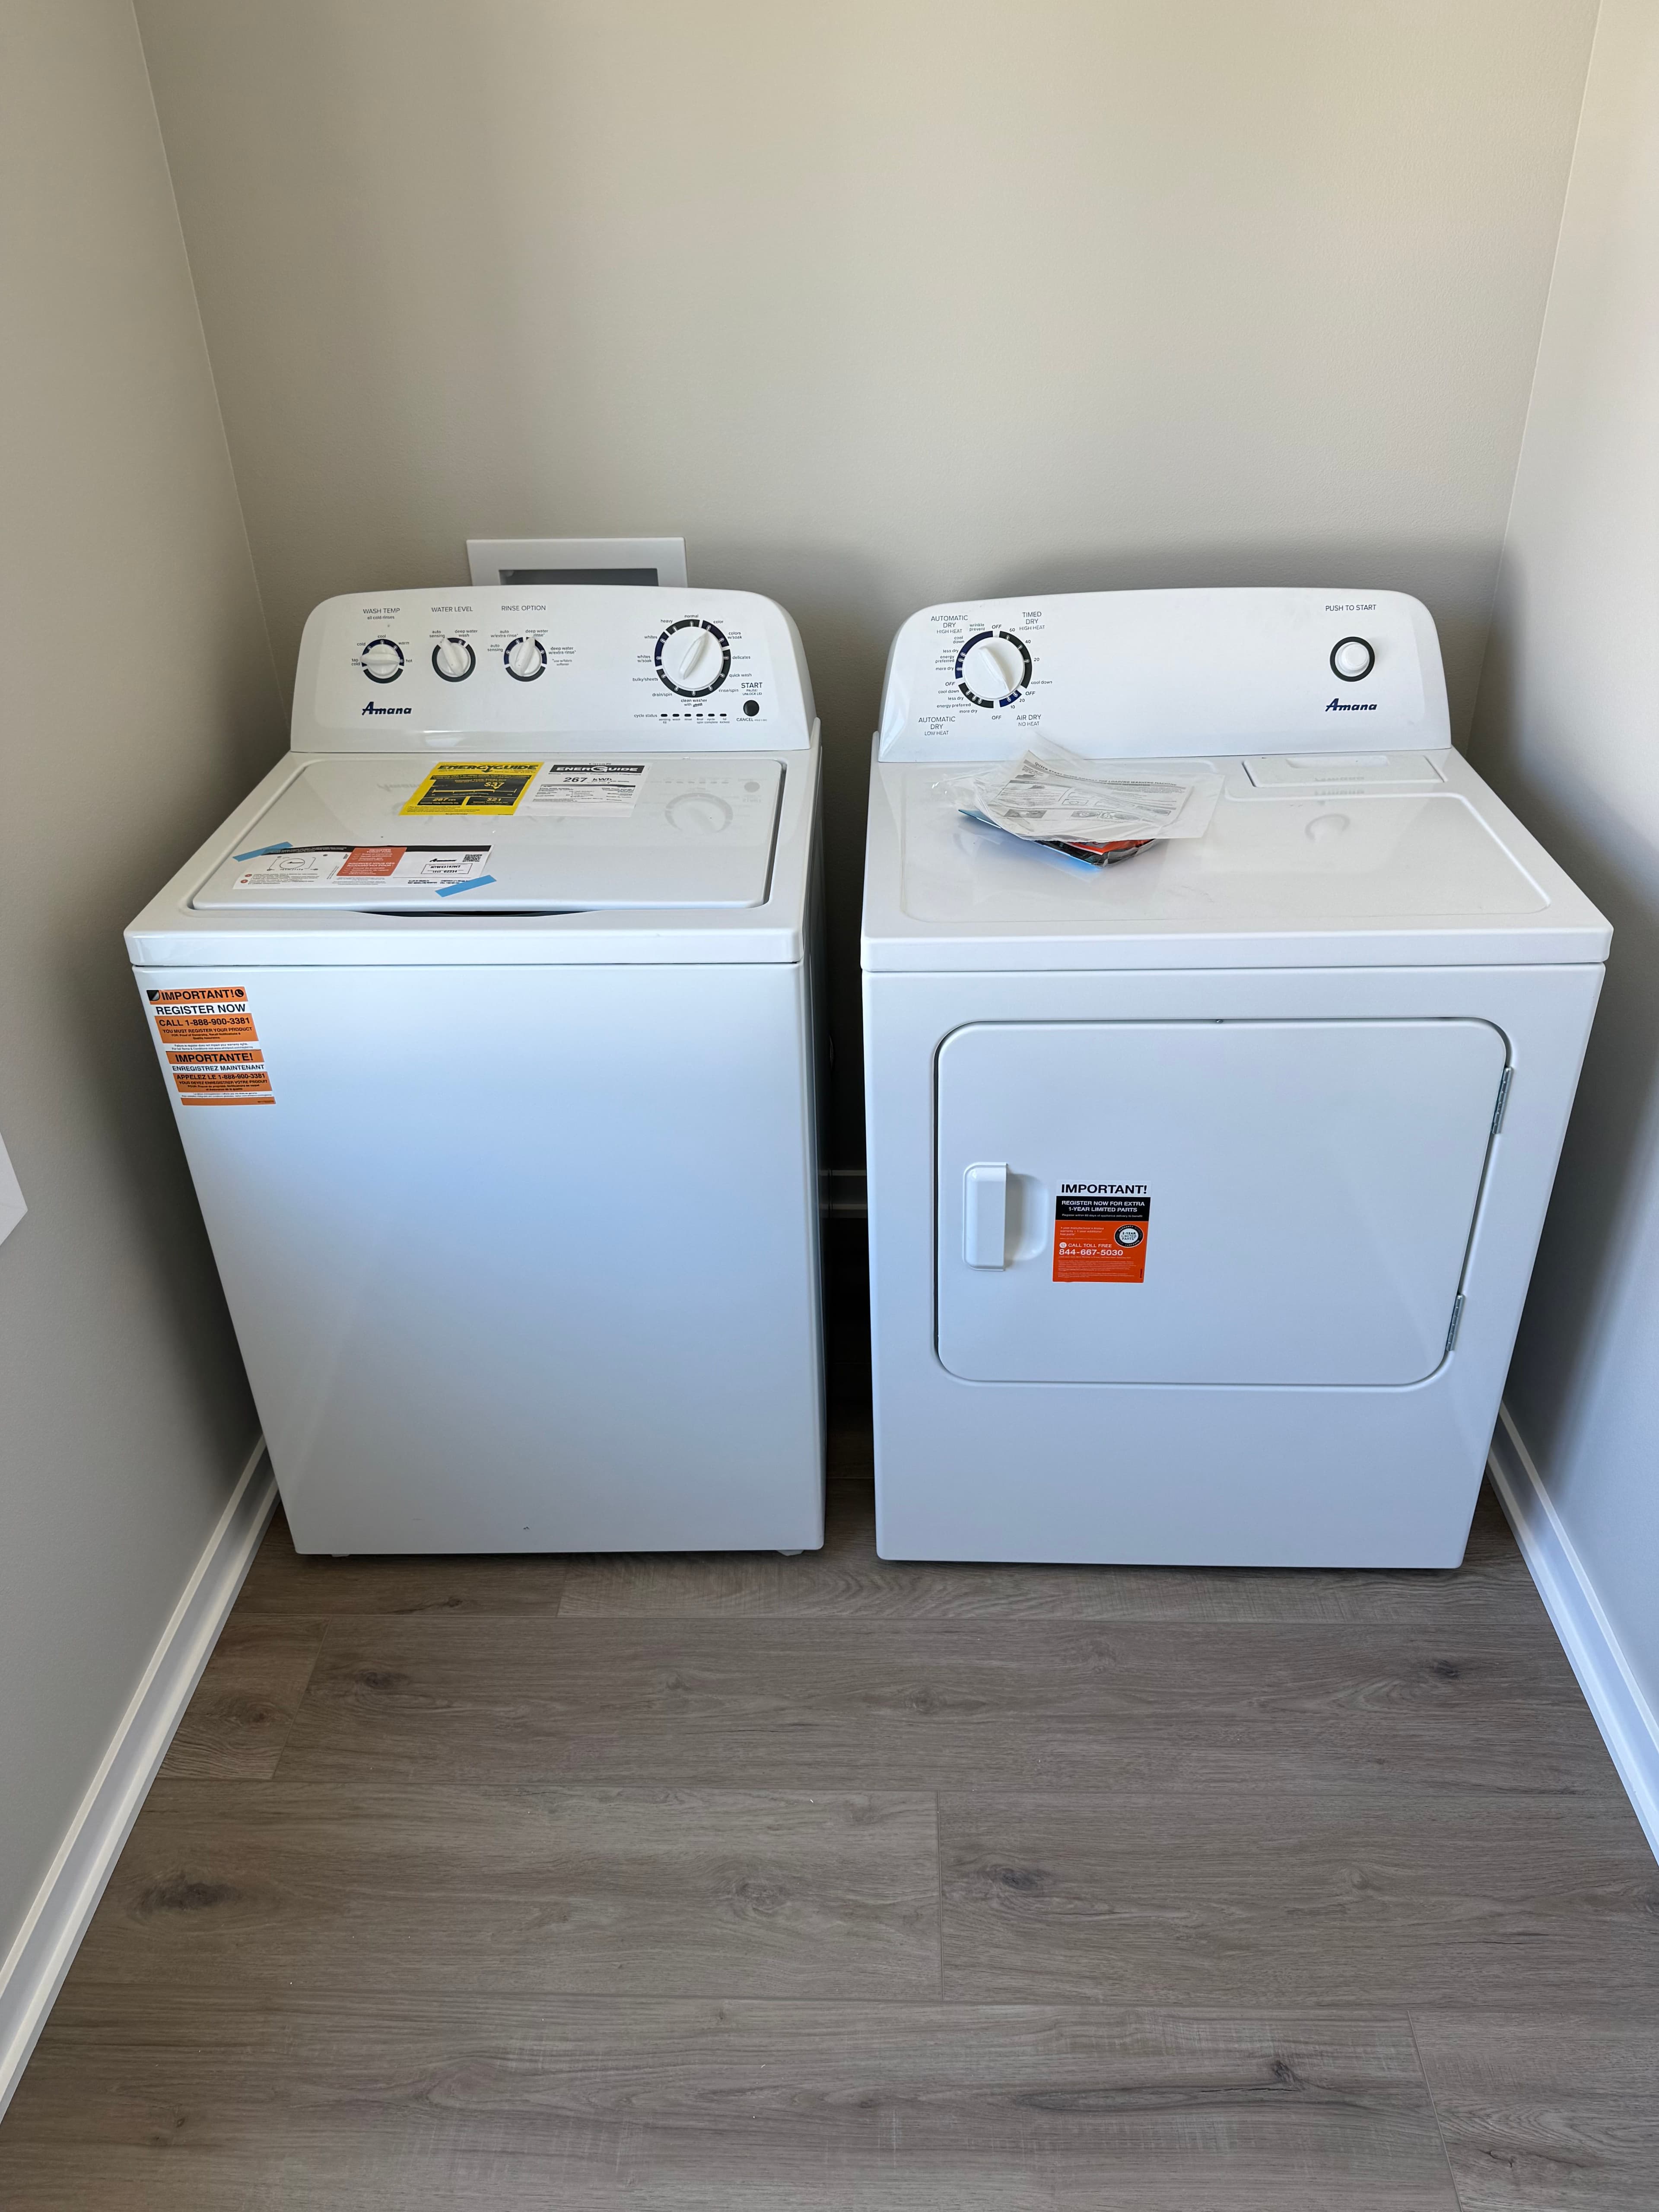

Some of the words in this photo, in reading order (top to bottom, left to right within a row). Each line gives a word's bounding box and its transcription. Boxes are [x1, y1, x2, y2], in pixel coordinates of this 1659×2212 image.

[362, 702, 412, 715] Amana
[1325, 698, 1377, 712] Amana
[161, 990, 235, 1000] IMPORTANT!
[156, 1005, 214, 1014] REGISTER
[218, 1004, 245, 1013] NOW
[185, 1017, 250, 1026] 1-888-900-3381
[175, 1053, 253, 1062] IMPORTANTE!
[1062, 1184, 1147, 1194] IMPORTANT!
